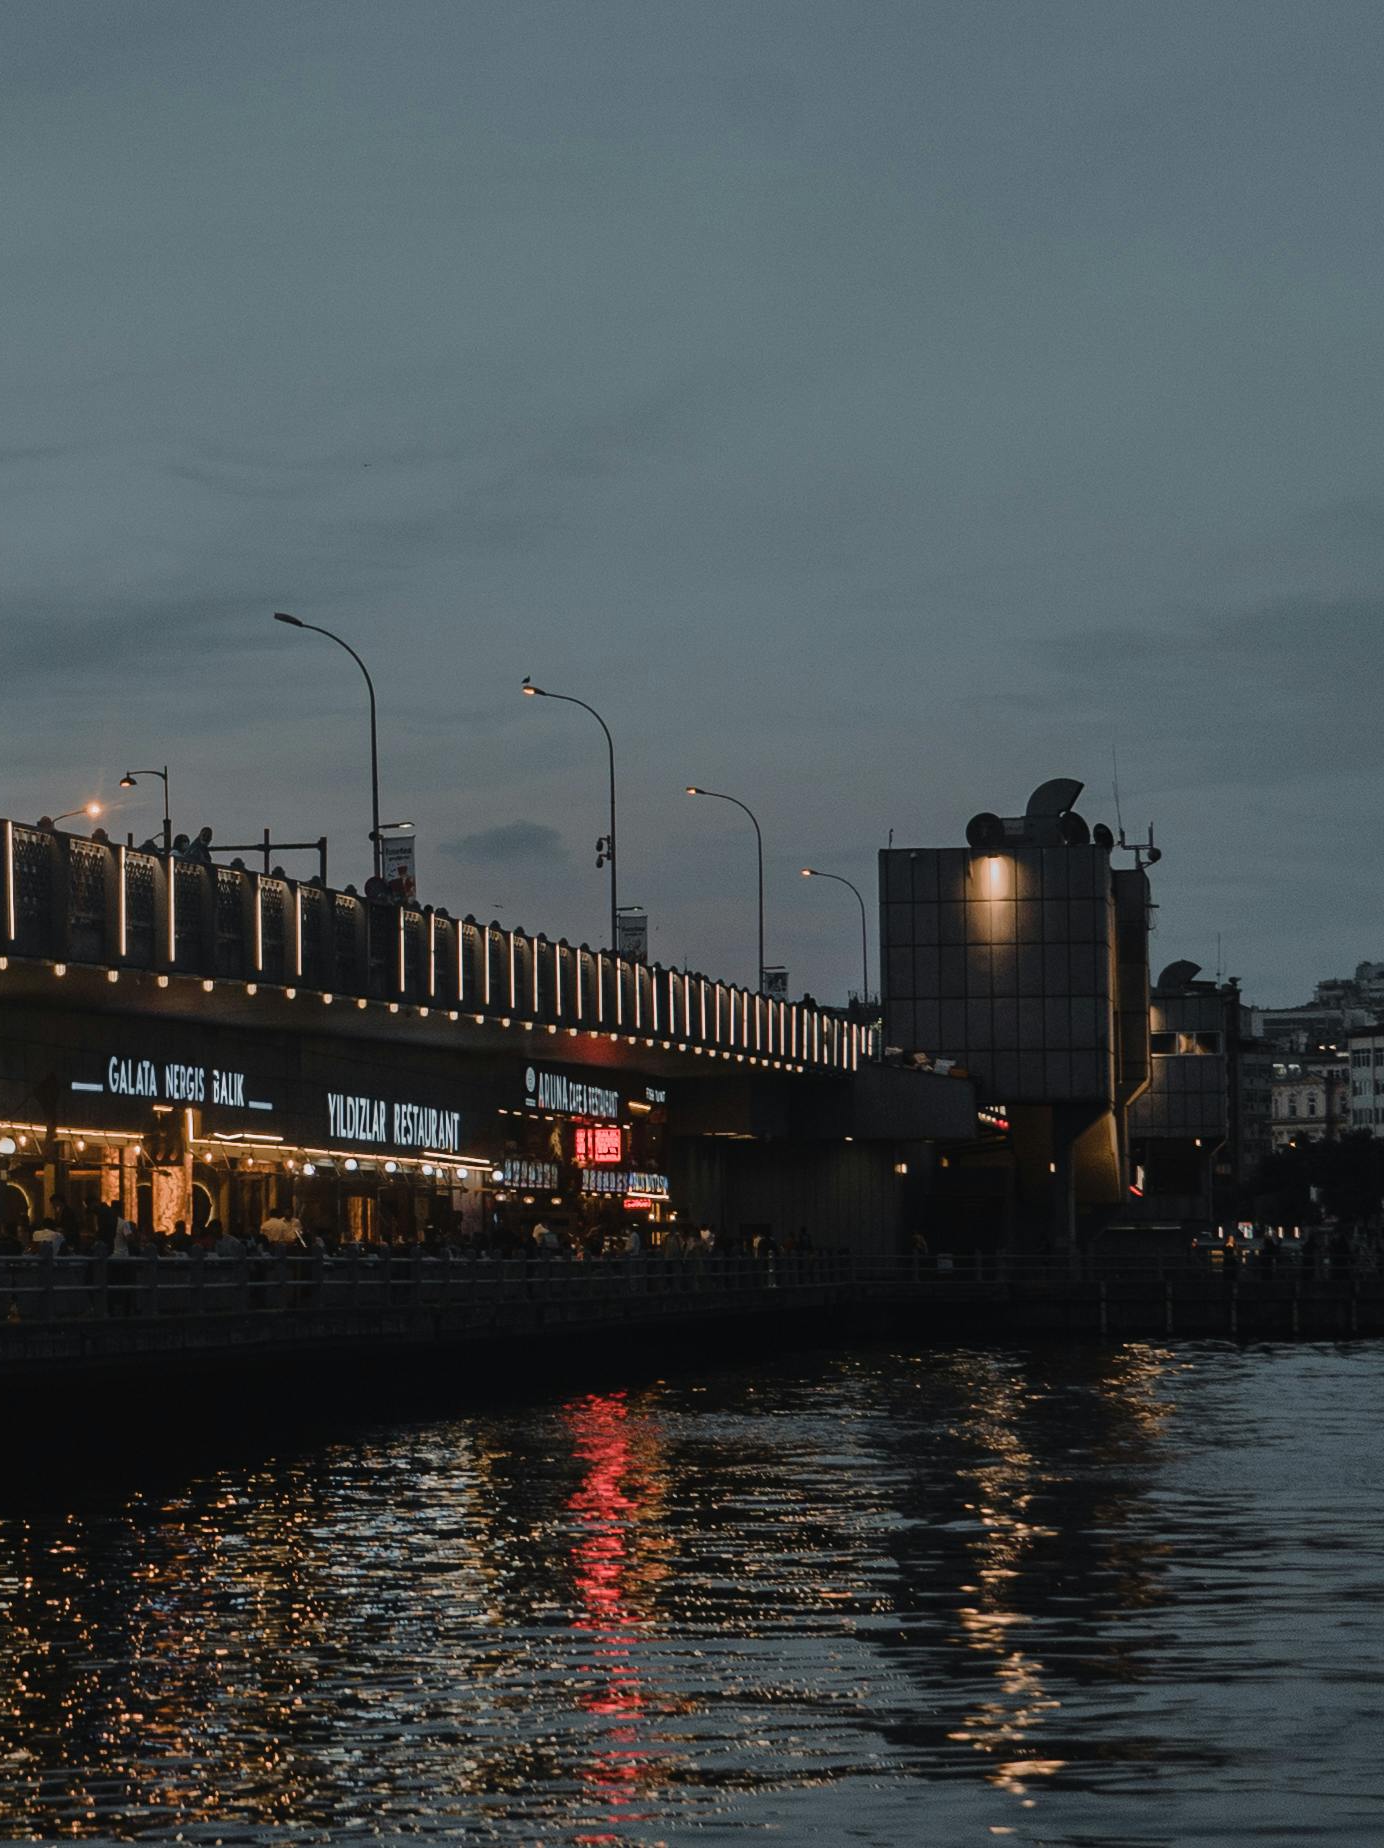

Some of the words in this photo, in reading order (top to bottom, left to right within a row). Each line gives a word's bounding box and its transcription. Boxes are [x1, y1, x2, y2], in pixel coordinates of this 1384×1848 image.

[108, 1055, 158, 1097] GALATA
[165, 1063, 205, 1102] NERGIS
[212, 1069, 245, 1107] BALIK
[538, 1072, 569, 1111] ARUNA
[327, 1092, 387, 1142] YILDIZLAR
[393, 1103, 460, 1153] RESTAURANT
